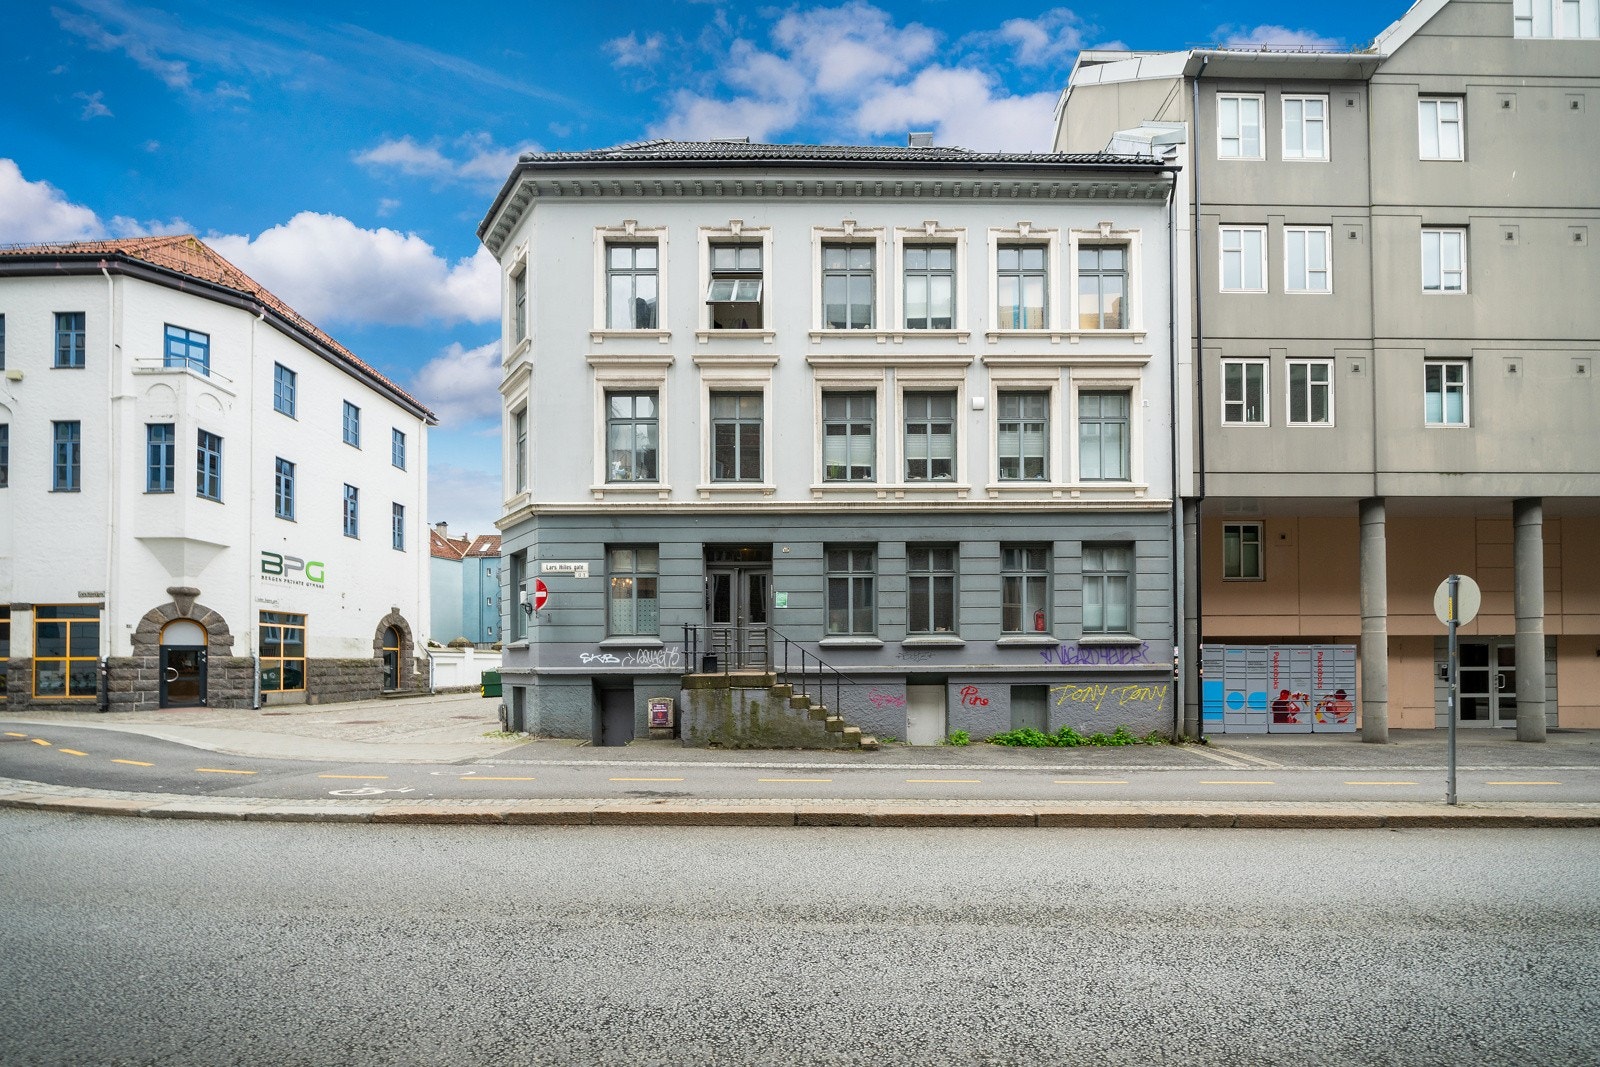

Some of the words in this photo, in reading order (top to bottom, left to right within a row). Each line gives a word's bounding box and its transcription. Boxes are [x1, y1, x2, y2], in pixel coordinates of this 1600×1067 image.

[261, 550, 325, 583] BPG
[573, 564, 584, 572] gate
[283, 578, 304, 586] PRIVATE
